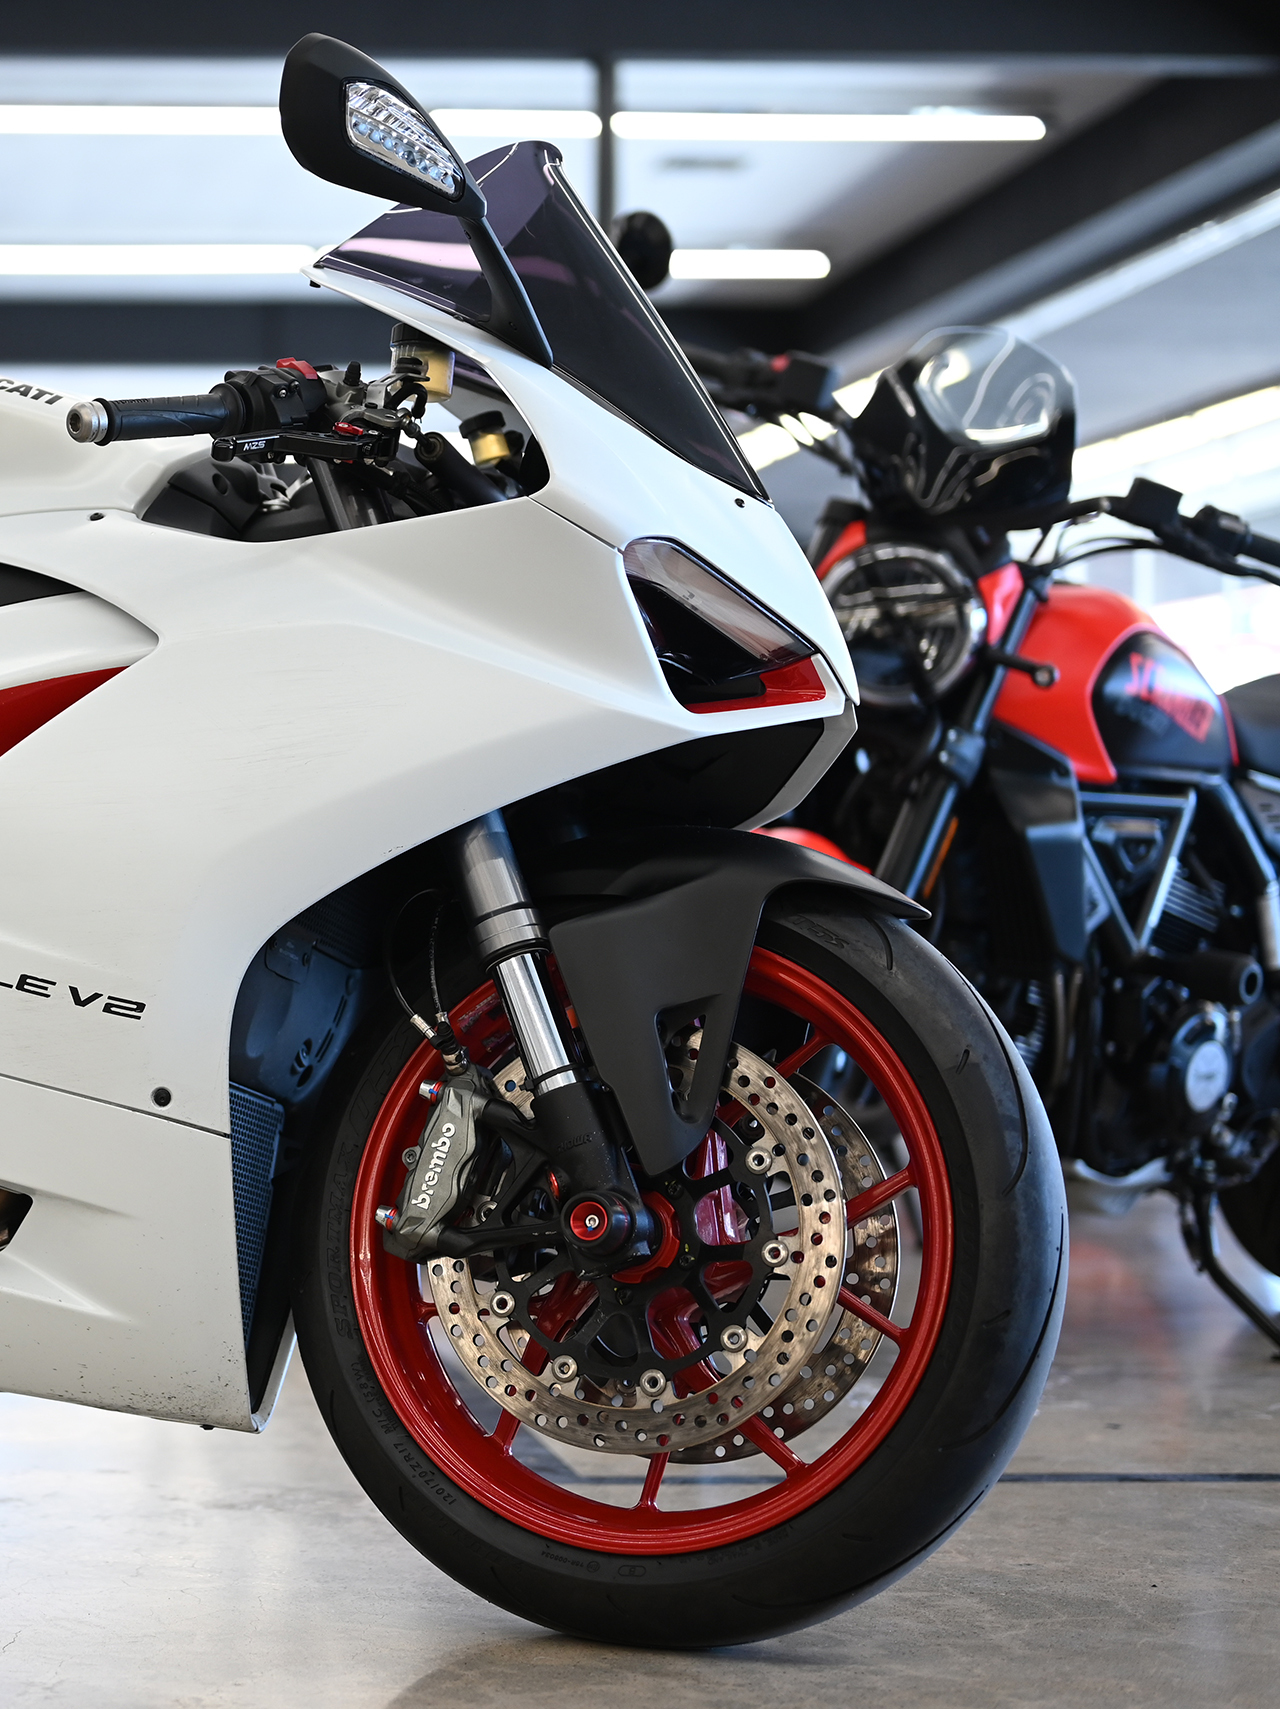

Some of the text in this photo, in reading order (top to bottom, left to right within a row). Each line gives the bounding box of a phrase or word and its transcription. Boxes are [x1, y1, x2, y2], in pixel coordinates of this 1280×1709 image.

[243, 440, 267, 451] MZS
[69, 985, 146, 1020] V2
[411, 1122, 456, 1210] brembo
[326, 1142, 354, 1340] SPORTMAX
[392, 1442, 457, 1506] 120/70ZR17
